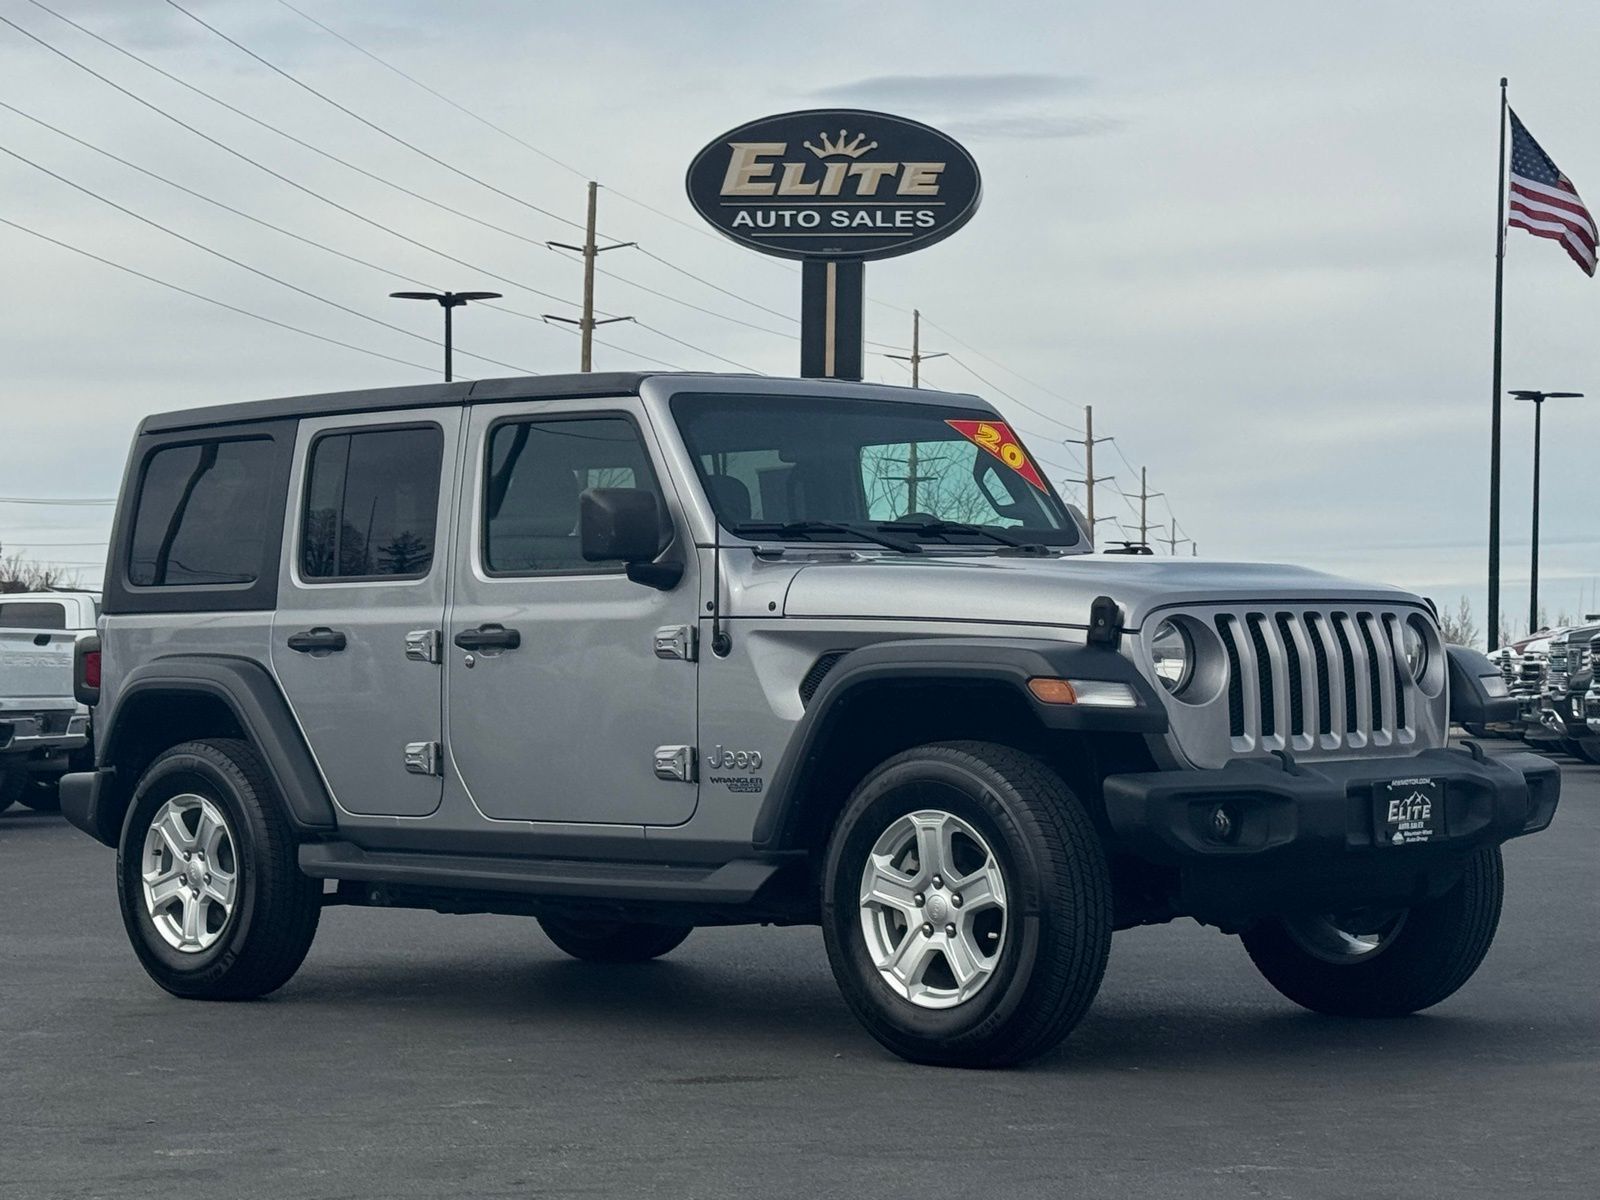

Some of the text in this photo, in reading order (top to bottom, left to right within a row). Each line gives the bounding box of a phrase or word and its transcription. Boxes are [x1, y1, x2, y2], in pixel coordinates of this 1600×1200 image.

[719, 142, 946, 197] ELITE
[731, 210, 936, 228] AUTO SALES
[974, 423, 1025, 469] 20
[707, 744, 763, 775] Jeep
[709, 776, 762, 784] WRANGLER
[1388, 800, 1431, 822] ELITE
